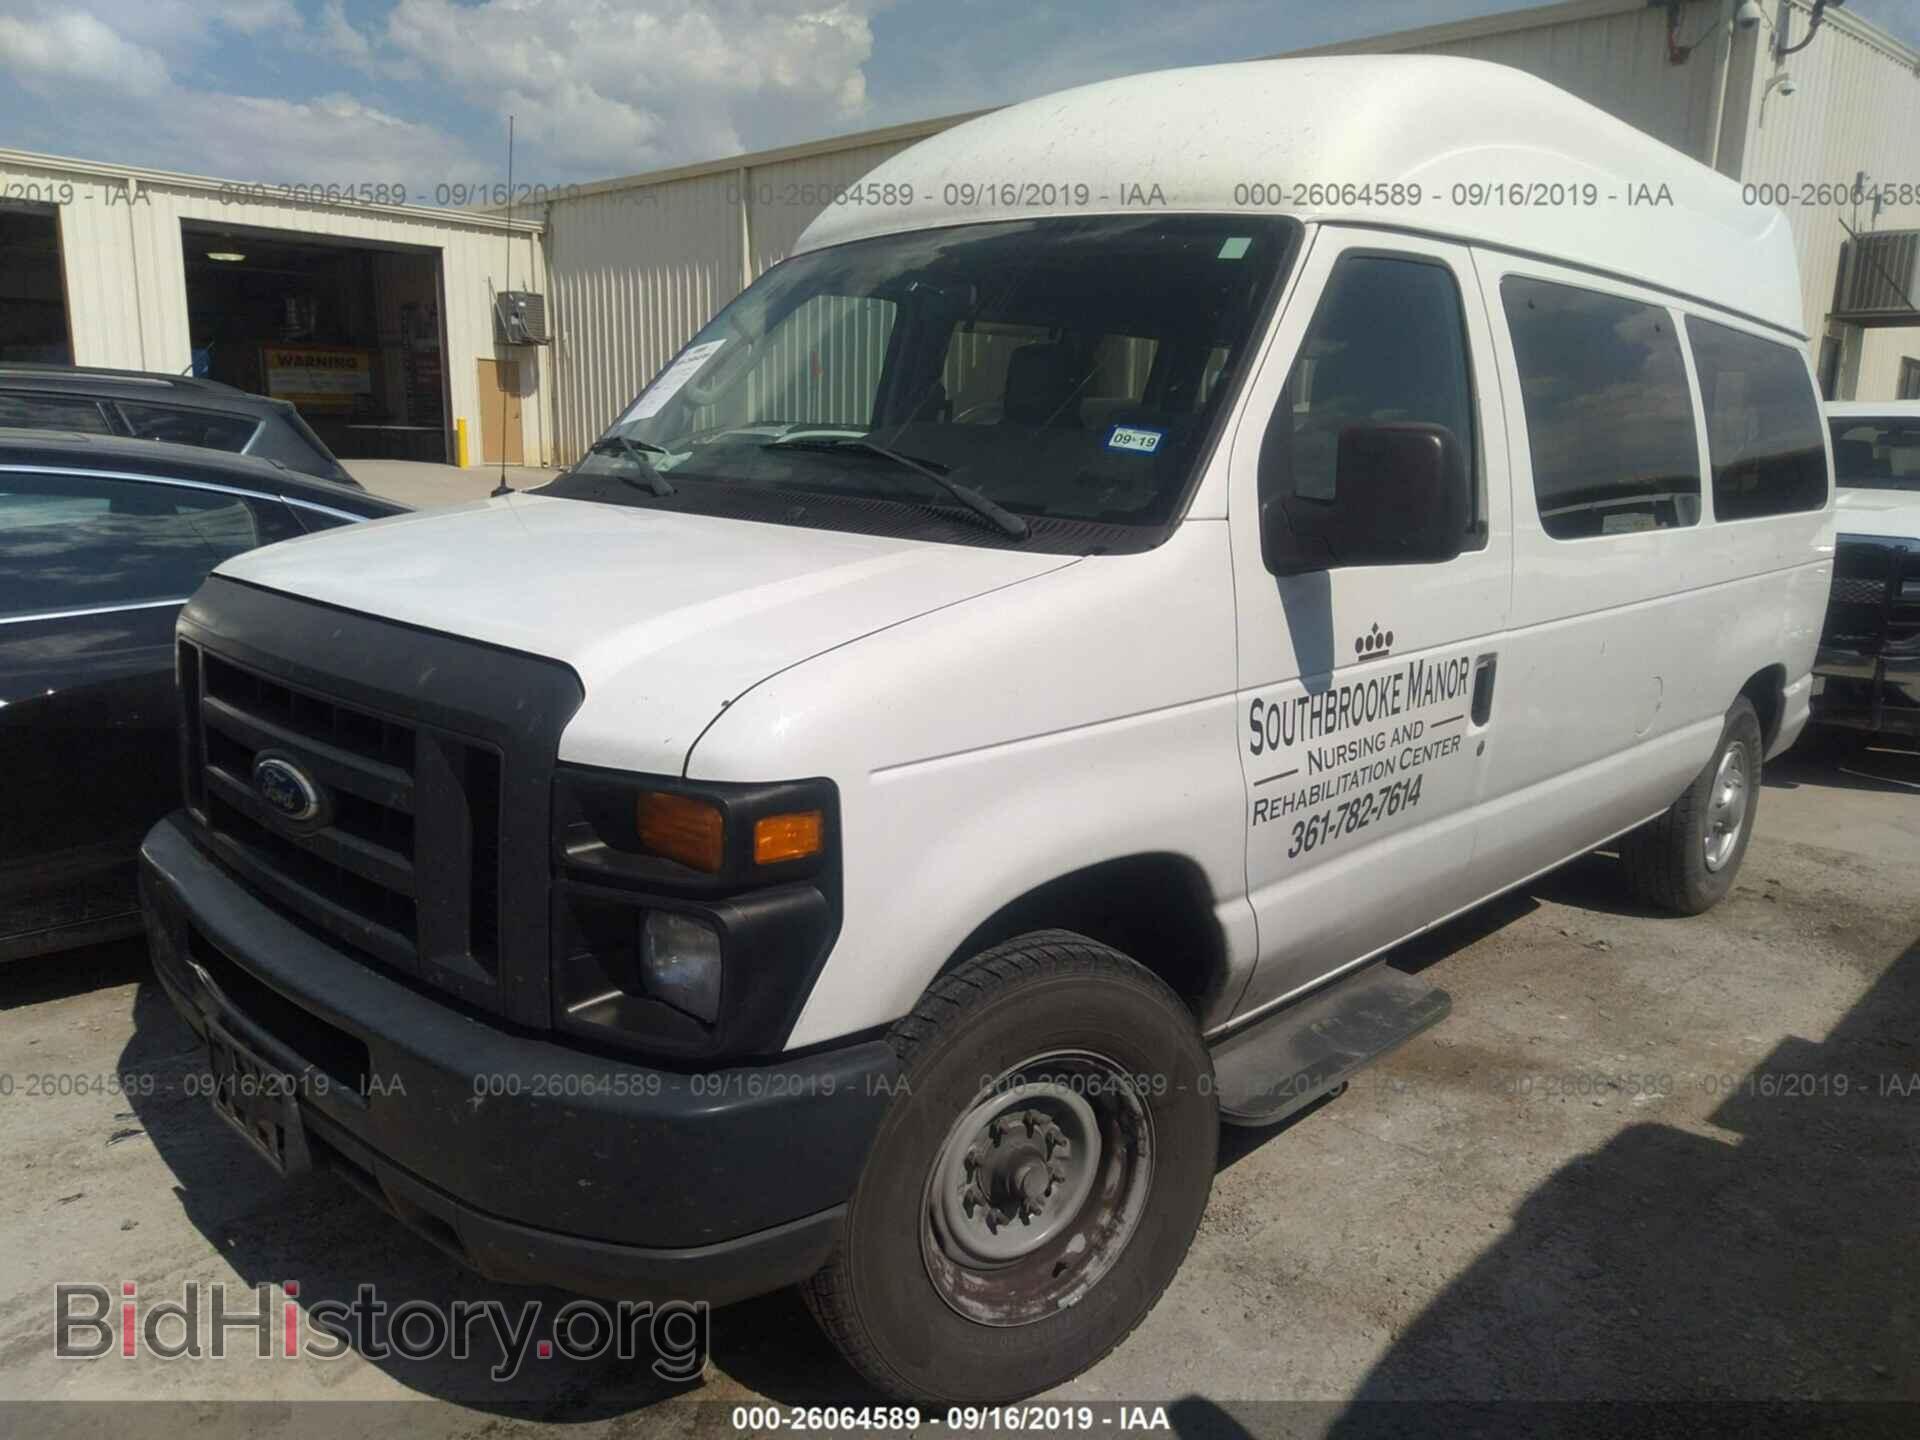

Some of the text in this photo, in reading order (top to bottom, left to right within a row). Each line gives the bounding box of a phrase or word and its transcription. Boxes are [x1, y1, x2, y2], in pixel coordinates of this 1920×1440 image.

[277, 353, 359, 369] WARNING
[1250, 656, 1470, 756] SOUTHBROOKE MANOR
[1306, 720, 1424, 775] NURSING AND
[1252, 734, 1462, 826] REHABILITATION CENTER
[1288, 774, 1423, 859] 361-782-7614
